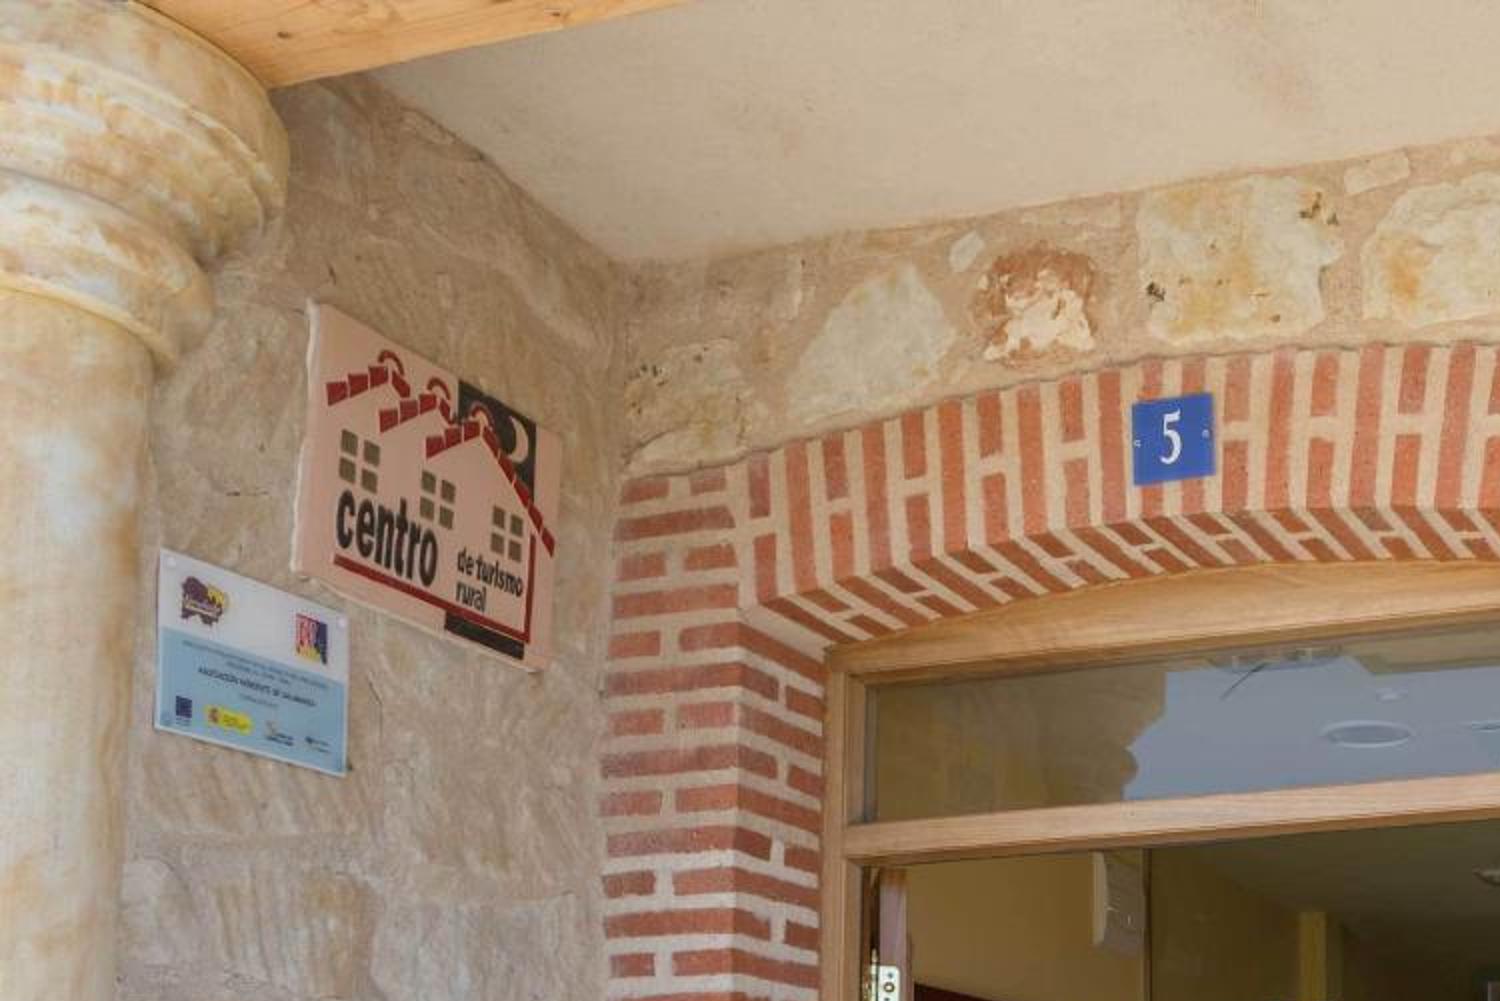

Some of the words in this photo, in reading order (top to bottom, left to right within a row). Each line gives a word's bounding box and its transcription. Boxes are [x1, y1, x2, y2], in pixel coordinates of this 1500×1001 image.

[1159, 408, 1182, 465] 5
[336, 489, 439, 588] centro
[455, 581, 488, 613] rural
[457, 546, 474, 577] de
[475, 554, 524, 598] turismo
